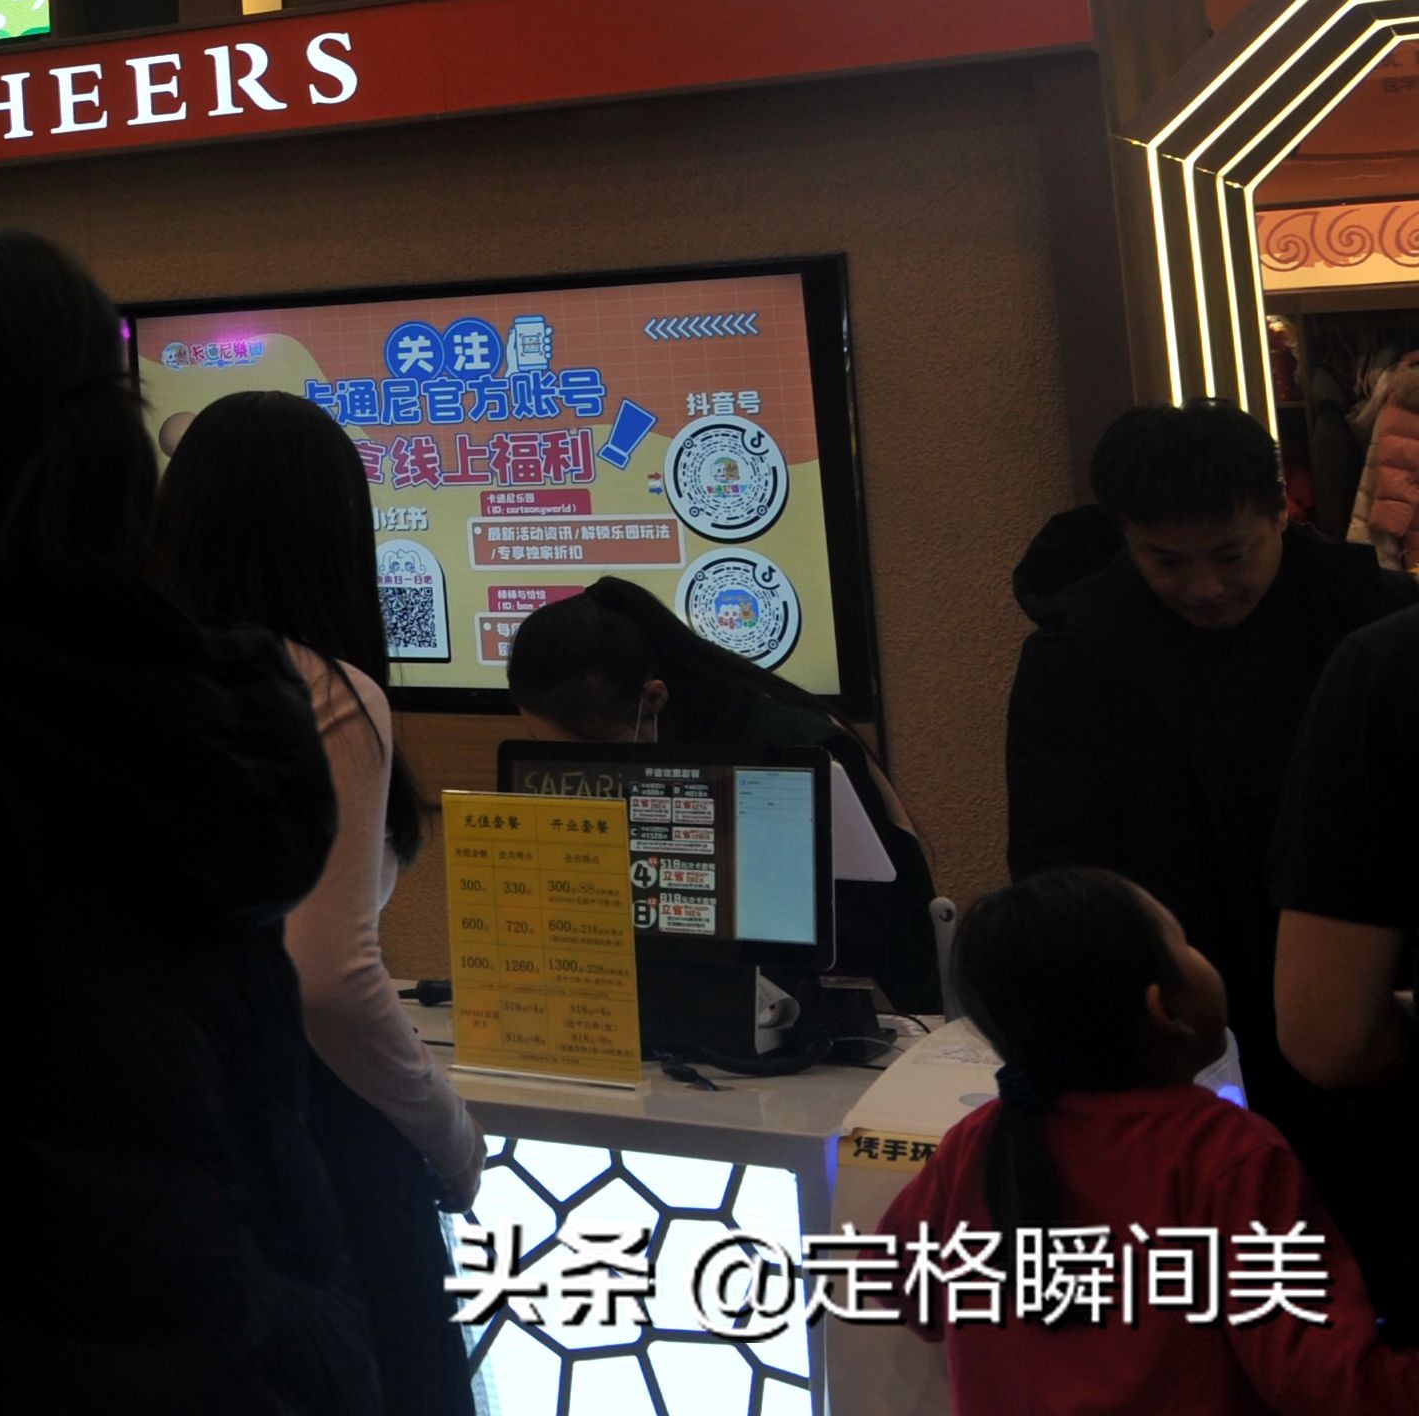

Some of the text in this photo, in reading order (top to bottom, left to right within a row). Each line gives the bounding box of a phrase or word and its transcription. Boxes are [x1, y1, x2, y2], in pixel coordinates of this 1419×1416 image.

[397, 331, 491, 374] 关注
[303, 368, 608, 427] 卡通尼官方账号
[686, 390, 761, 415] 抖音号
[464, 814, 610, 835] 充值套餐 开业套餐
